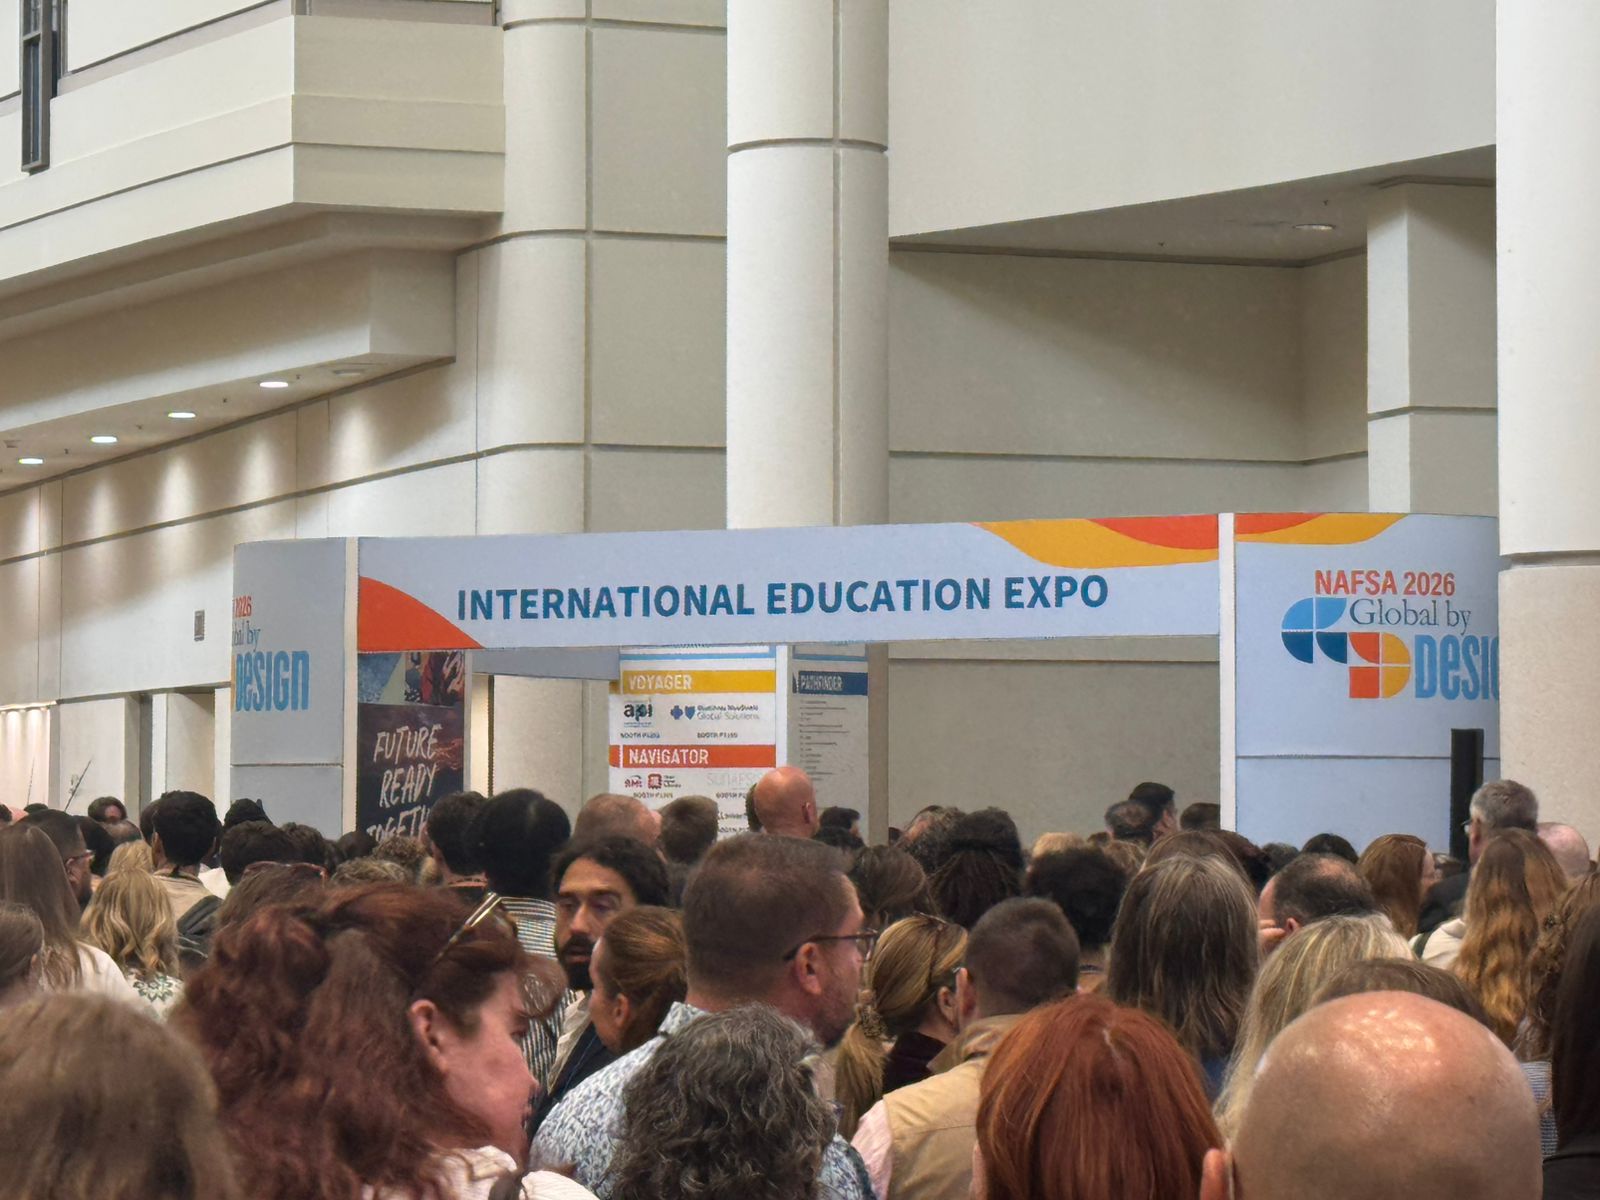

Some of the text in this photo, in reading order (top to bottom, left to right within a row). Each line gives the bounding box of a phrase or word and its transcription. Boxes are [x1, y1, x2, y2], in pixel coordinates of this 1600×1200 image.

[457, 574, 1110, 621] INTERNATIONAL EDUCATION EXPO
[1314, 569, 1456, 597] NAFSA 2026
[1349, 598, 1472, 635] Global by
[246, 619, 261, 653] by
[628, 674, 693, 691] VOYAGER
[373, 722, 443, 764] FUTURE
[628, 748, 709, 765] NAVIGATOR
[379, 763, 438, 808] READY
